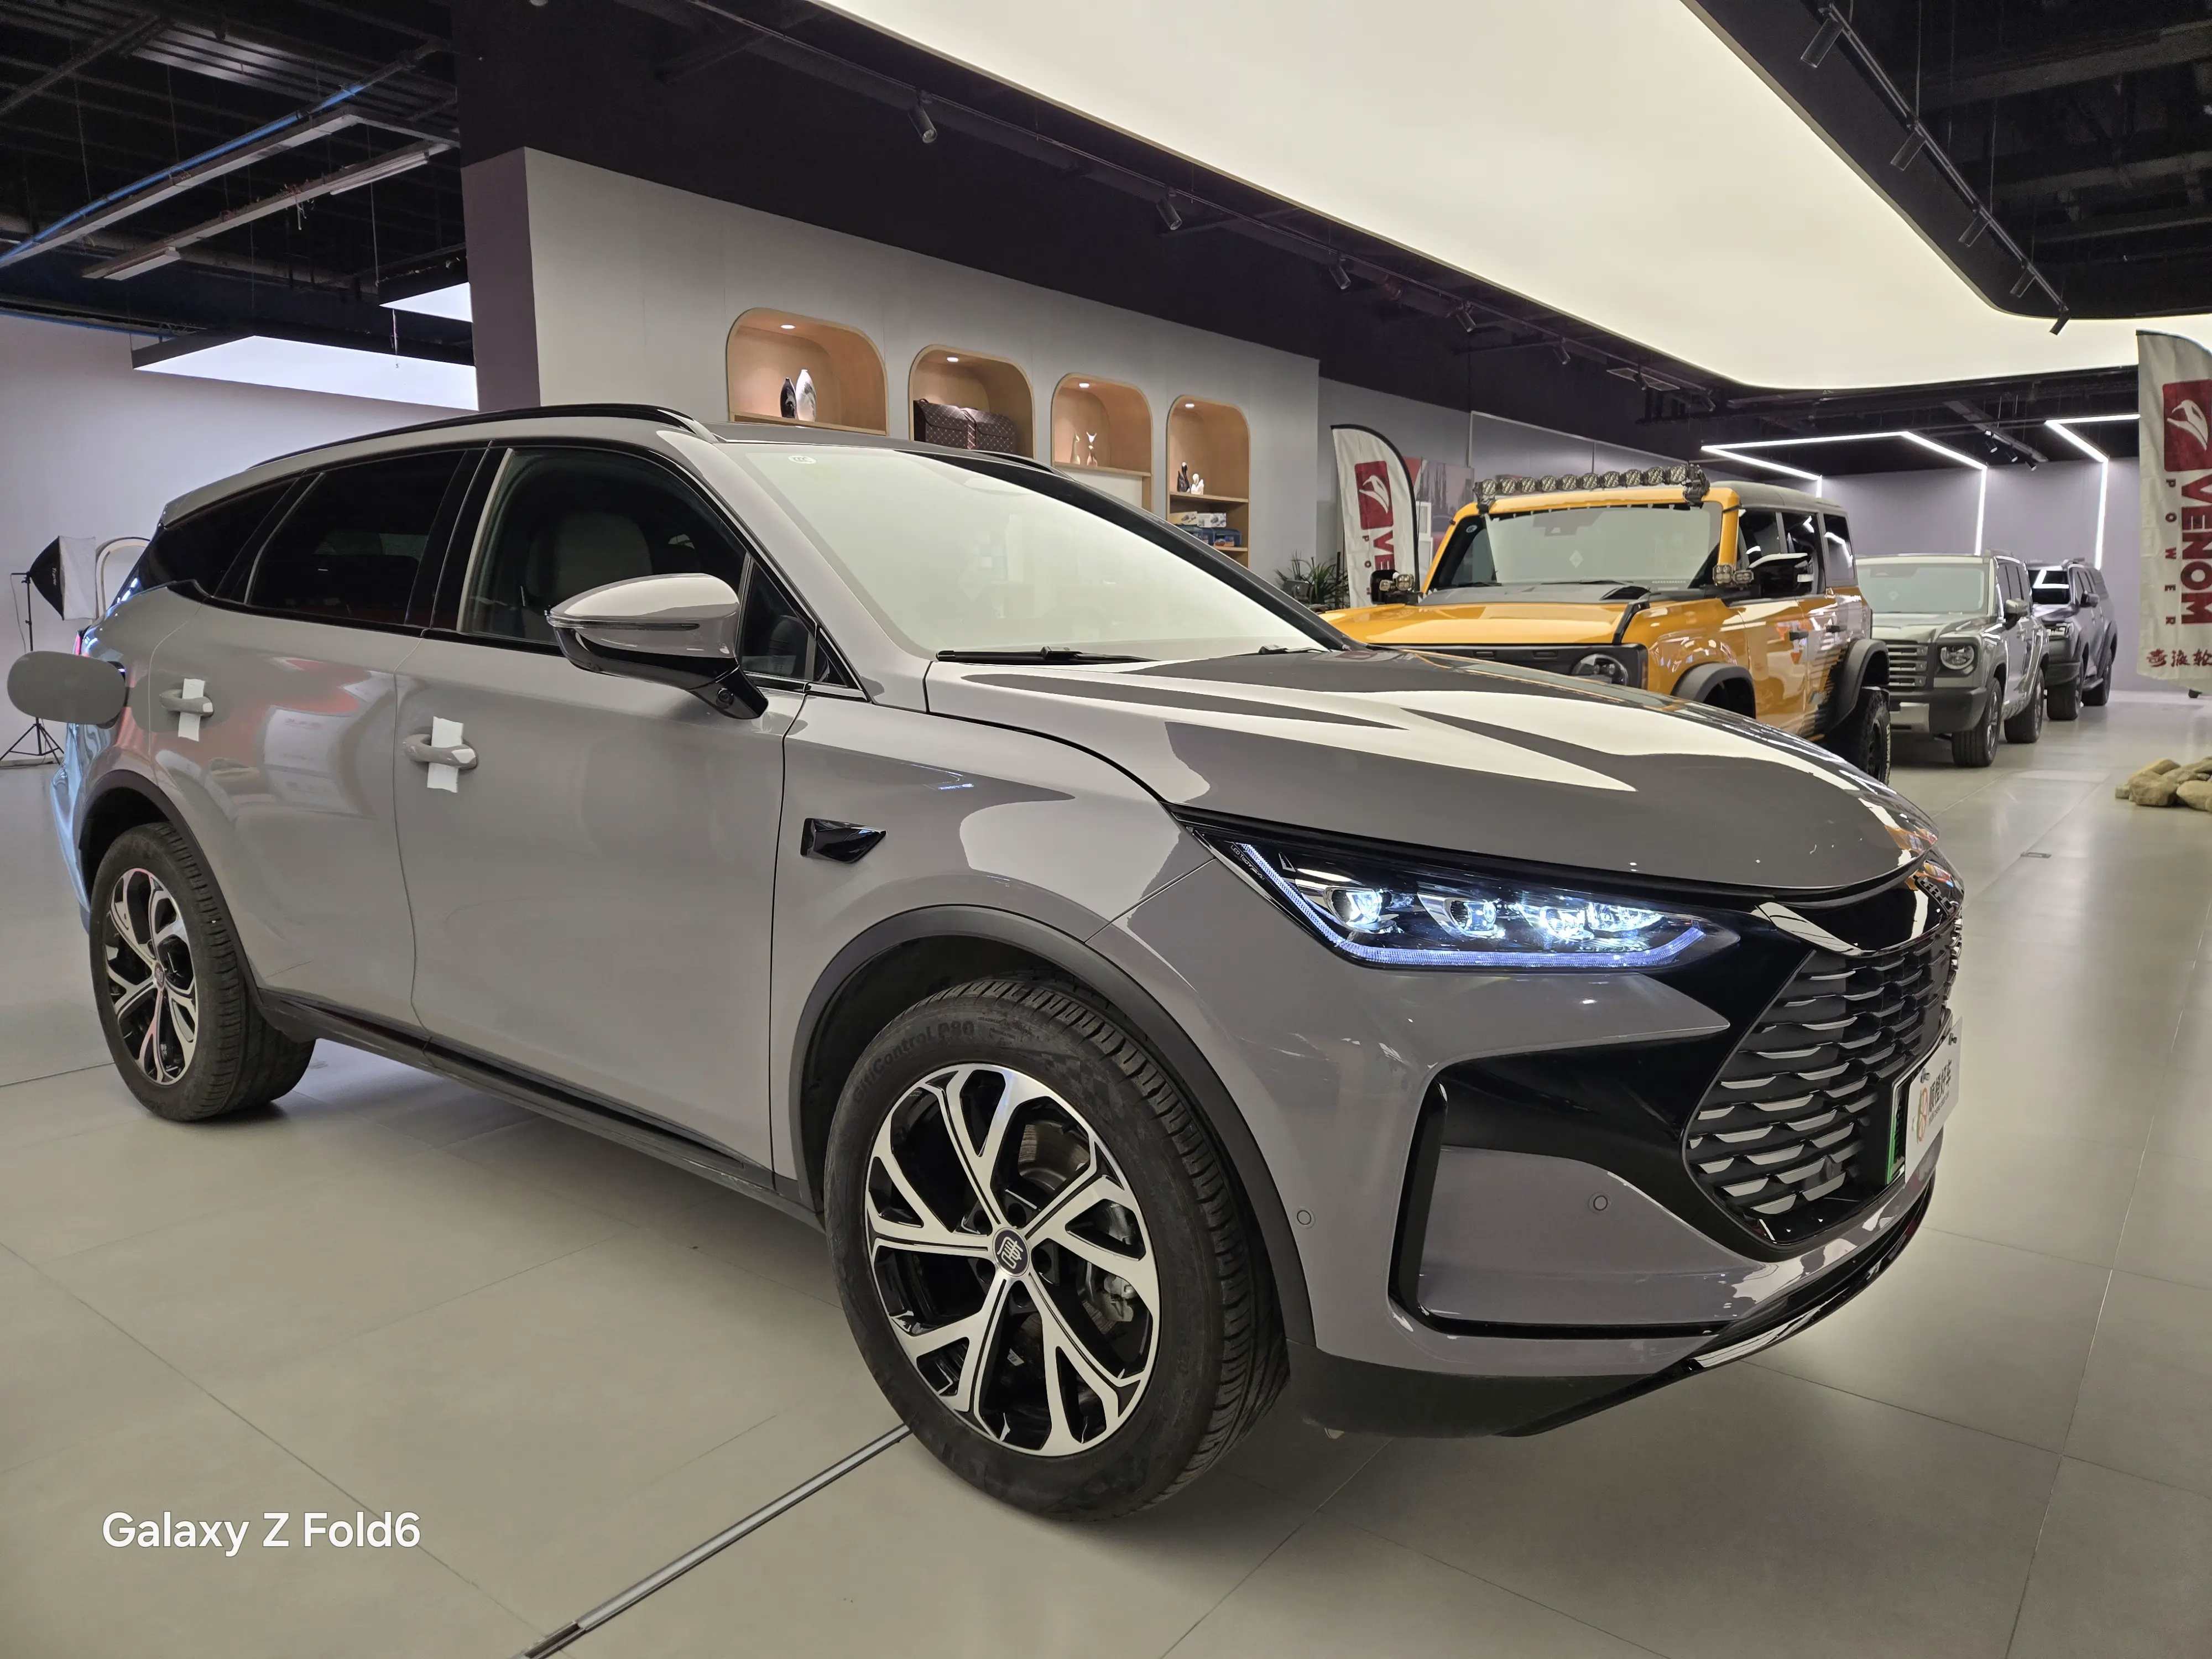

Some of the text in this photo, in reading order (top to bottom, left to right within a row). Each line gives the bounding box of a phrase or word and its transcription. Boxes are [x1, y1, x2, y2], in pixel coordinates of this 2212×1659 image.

[2164, 479, 2177, 625] POWER
[2180, 473, 2212, 624] VENOM
[1230, 845, 1240, 855] LED
